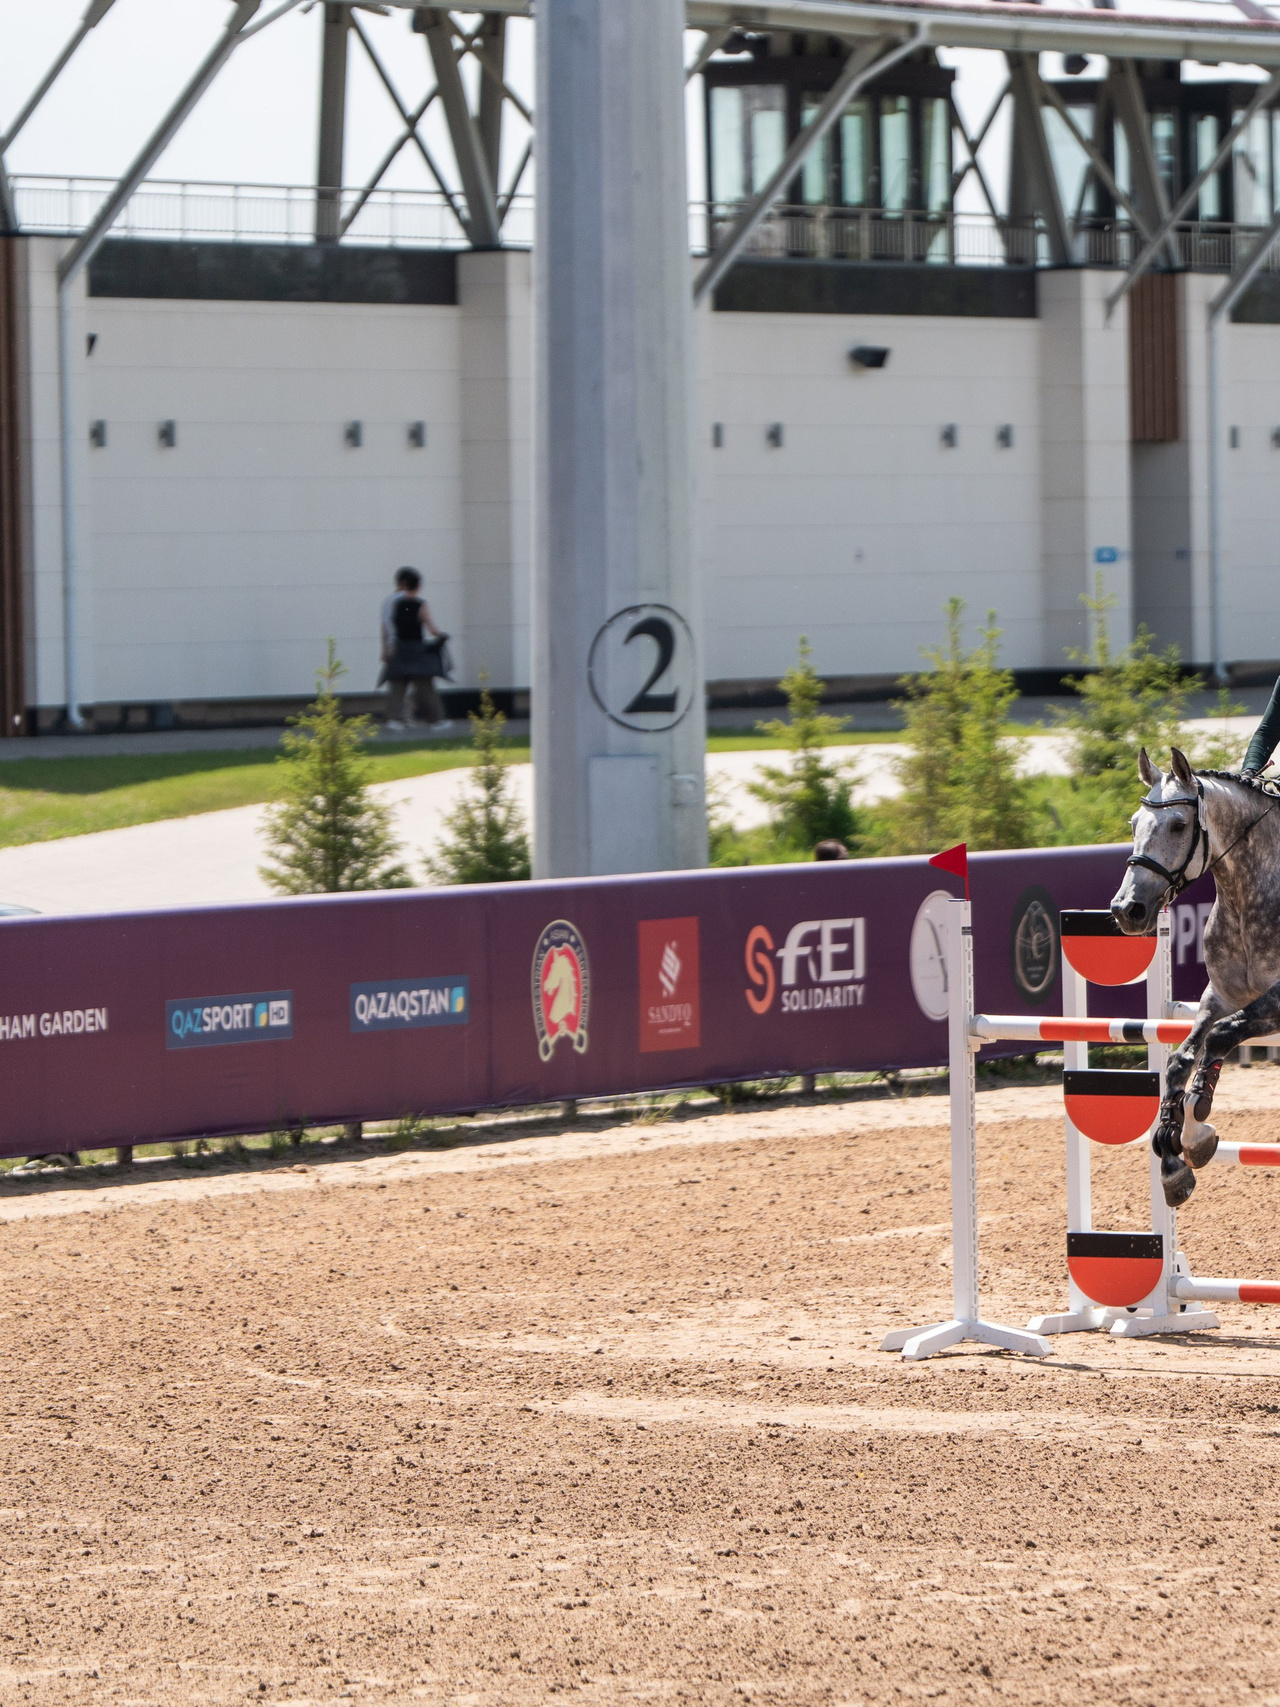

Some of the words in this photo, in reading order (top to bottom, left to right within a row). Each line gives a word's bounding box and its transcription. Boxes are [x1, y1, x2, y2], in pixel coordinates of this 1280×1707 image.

[622, 616, 679, 714] 2
[776, 917, 865, 985] FEI
[355, 987, 450, 1024] QAZAQSTAN
[648, 1003, 692, 1026] SANDYQ
[781, 984, 865, 1013] SOLIDARITY
[0, 1014, 36, 1040] HAM
[39, 1007, 108, 1035] GARDEN
[171, 1003, 253, 1038] QAZSPORT
